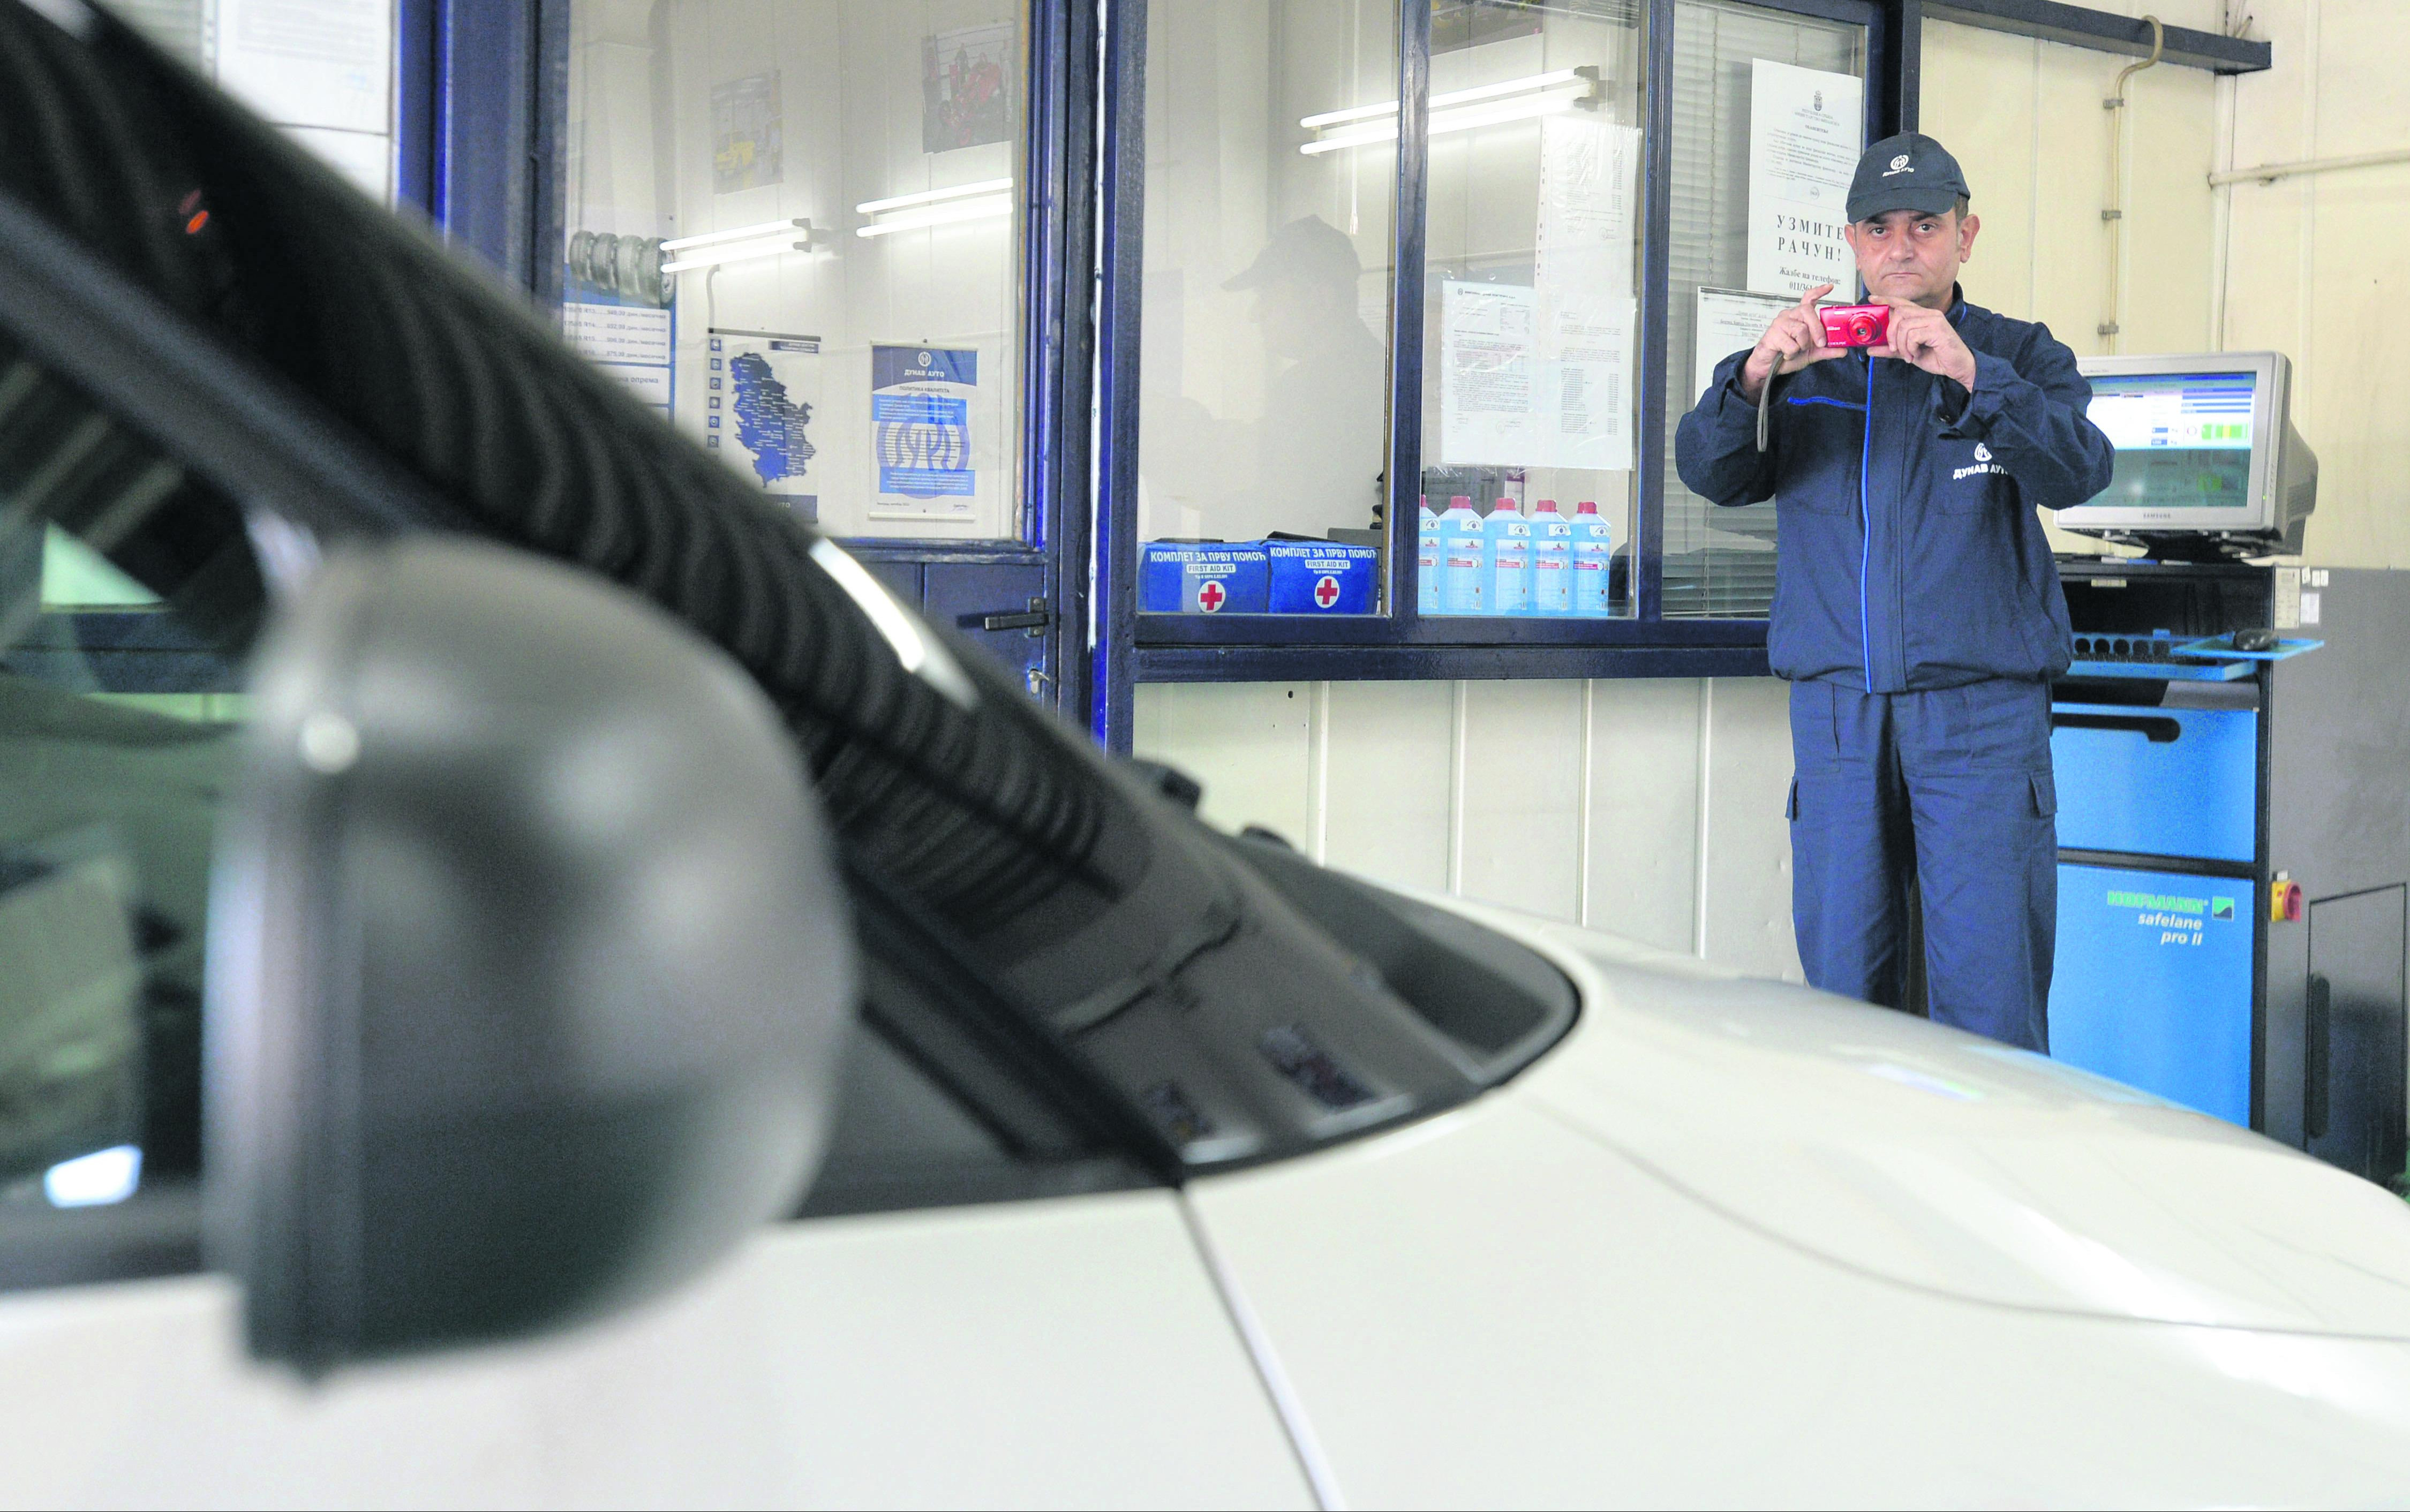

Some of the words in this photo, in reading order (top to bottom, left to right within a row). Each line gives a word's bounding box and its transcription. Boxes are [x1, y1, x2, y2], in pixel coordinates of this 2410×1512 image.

[1777, 215, 1843, 240] УЗМИТЕ
[1778, 236, 1841, 261] РАЧУН!
[1779, 266, 1801, 278] Жалбе
[1953, 464, 1989, 480] ДУНАВ
[1990, 464, 2008, 475] АУТ
[1150, 551, 1193, 562] КОМПЛЕТ
[1195, 551, 1208, 562] ЗА
[1208, 551, 1231, 562] ПРВУ
[1233, 551, 1266, 561] ПОМОЋ
[1270, 547, 1311, 557] КОМПЛЕТ
[1313, 548, 1325, 558] ЗА
[1326, 549, 1346, 558] ПРВУ
[2138, 912, 2203, 931] safelane
[2160, 931, 2188, 946] pro
